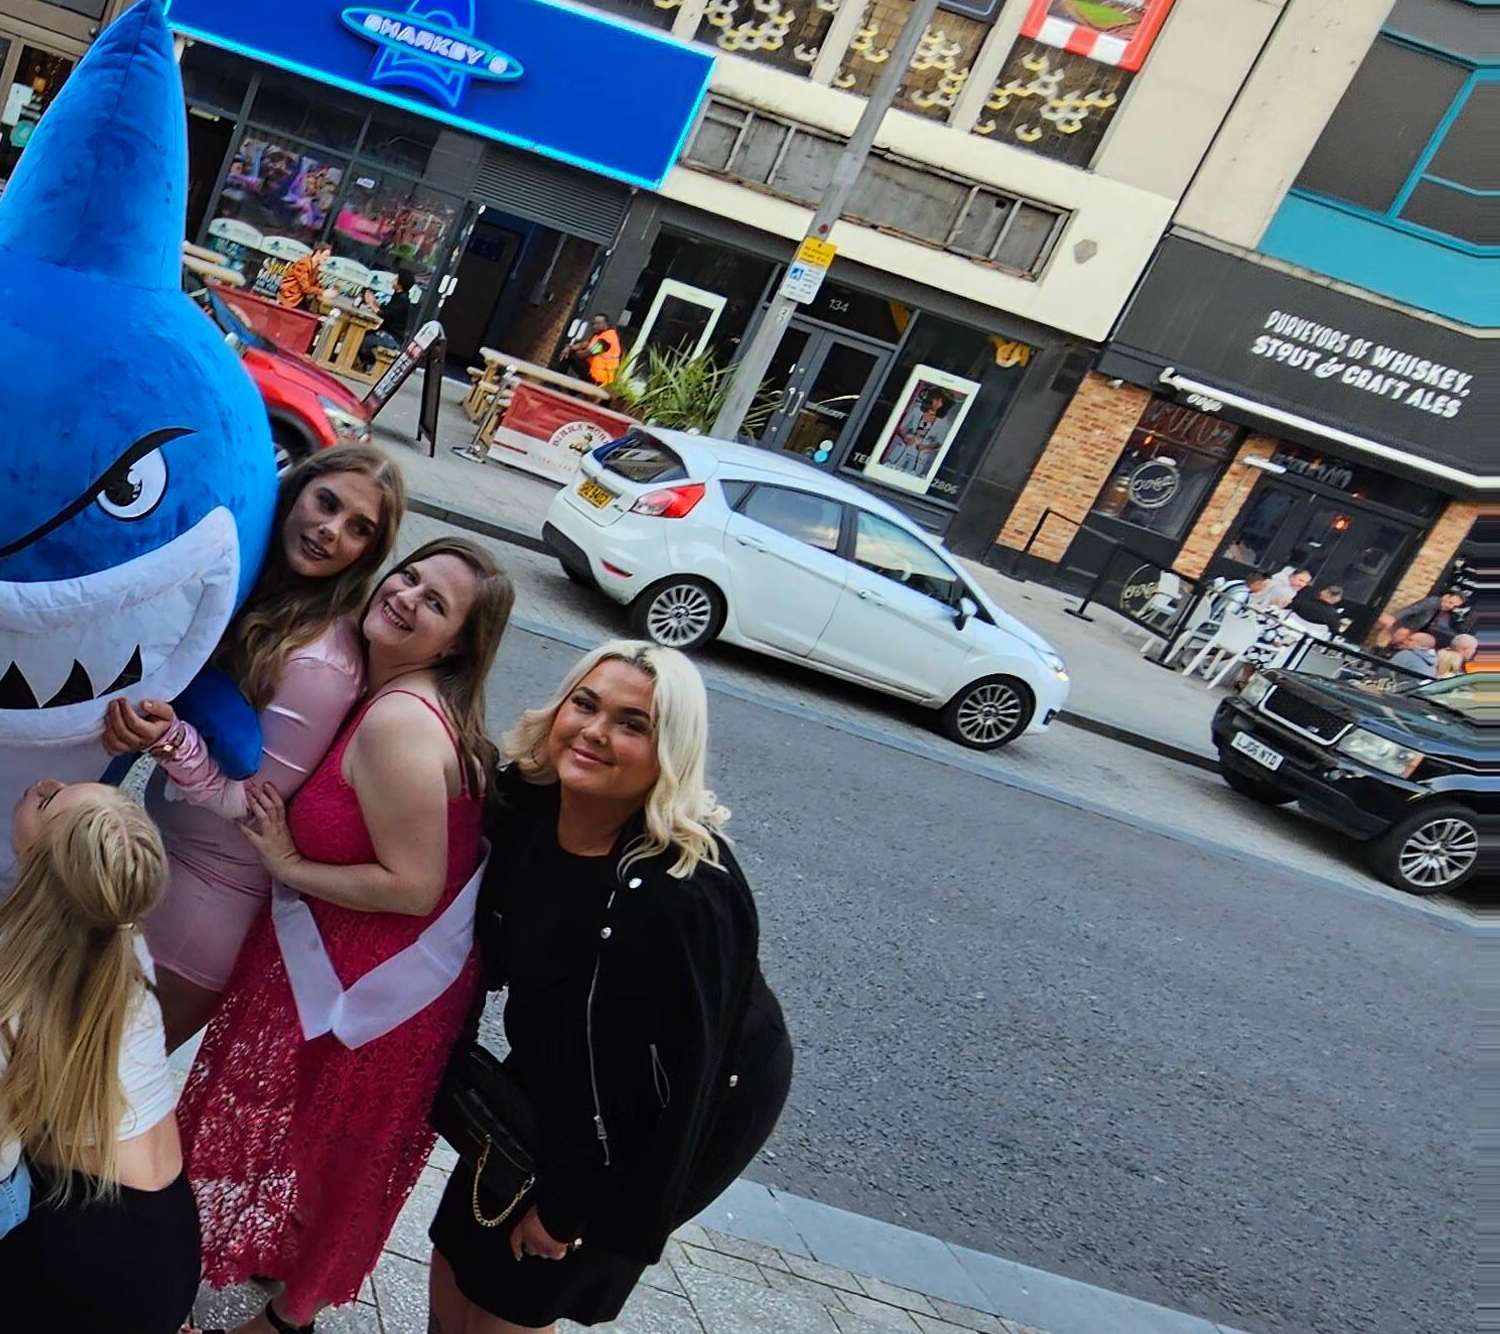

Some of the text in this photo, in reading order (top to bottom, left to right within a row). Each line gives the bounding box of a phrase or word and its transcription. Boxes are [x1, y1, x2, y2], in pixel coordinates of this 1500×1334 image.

[363, 13, 510, 75] SHARKEY'S
[828, 298, 850, 313] 134
[1251, 334, 1463, 418] STOUT & CRAFT ALES
[1263, 309, 1475, 398] PURVEYORS OF WHISKEY,
[552, 423, 583, 447] BIRRA
